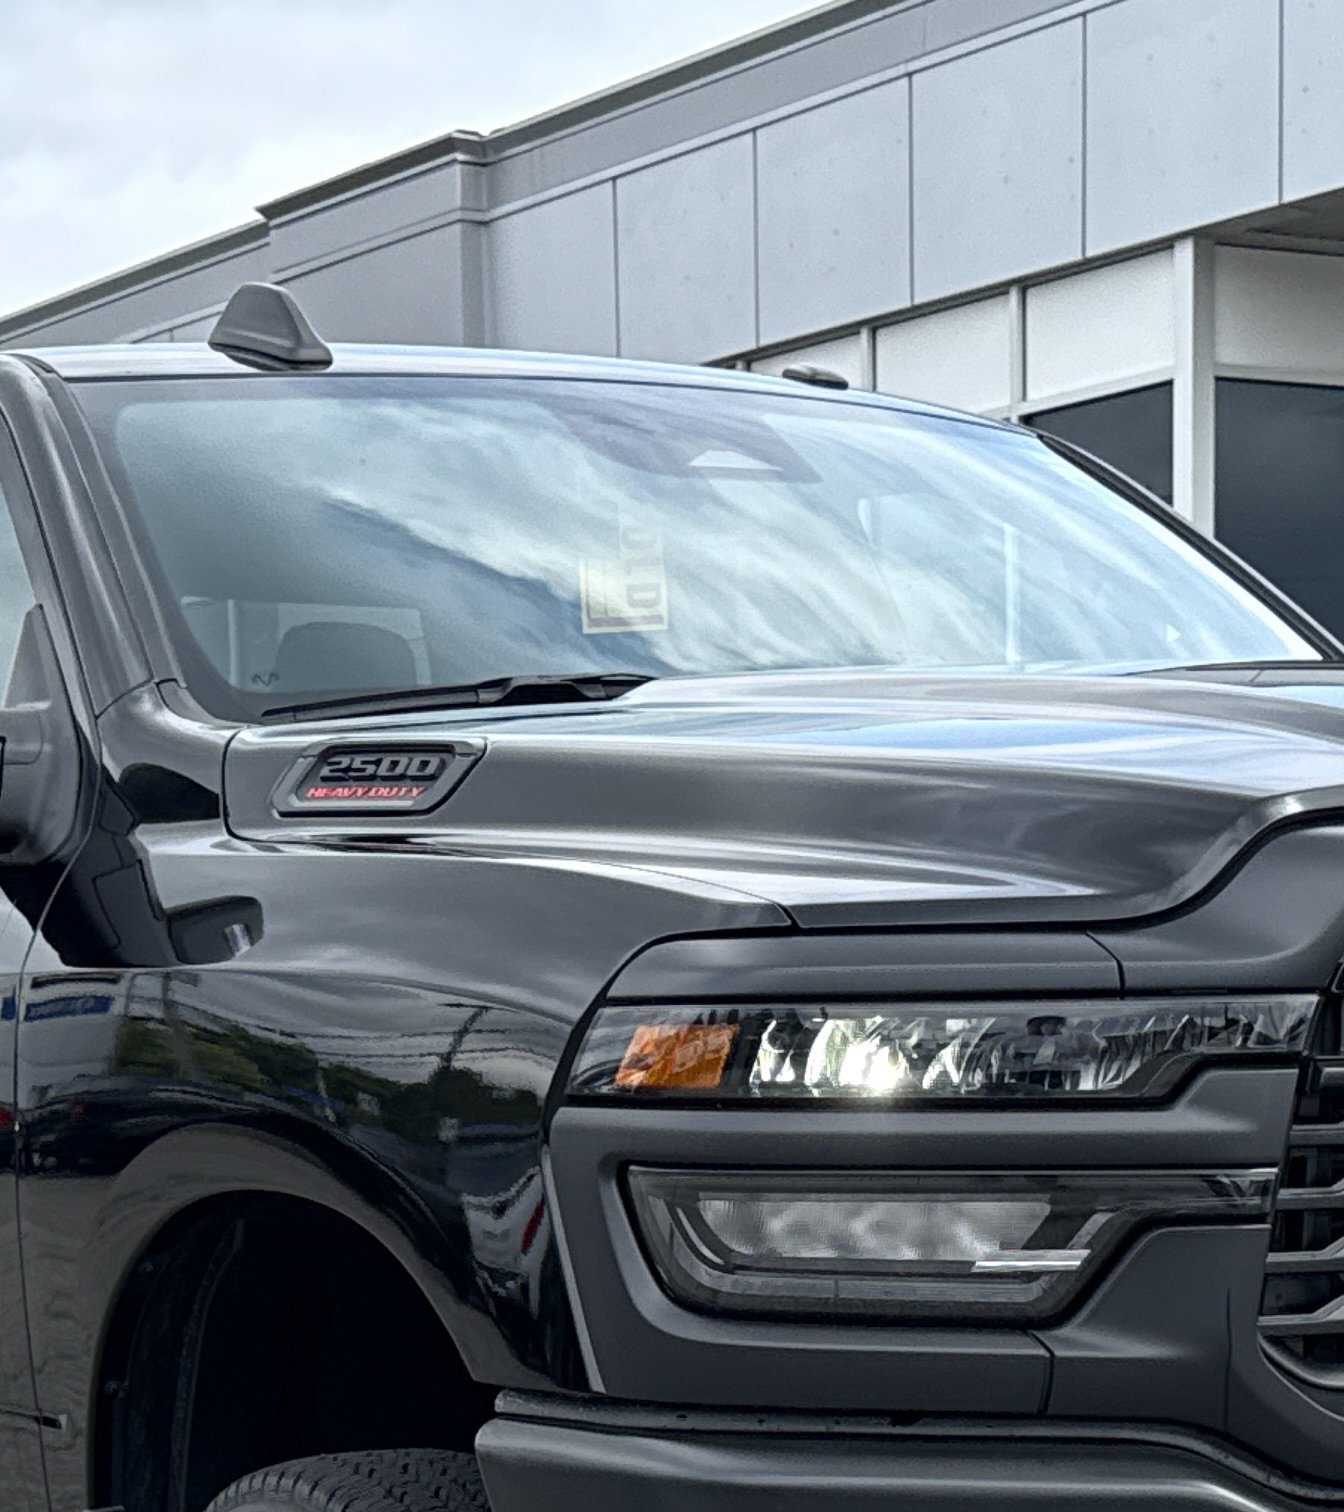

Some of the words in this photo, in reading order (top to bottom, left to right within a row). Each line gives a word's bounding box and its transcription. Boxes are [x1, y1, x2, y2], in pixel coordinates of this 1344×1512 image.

[321, 757, 439, 780] 2500
[306, 786, 368, 798] HEAVY
[368, 786, 424, 798] DUTY
